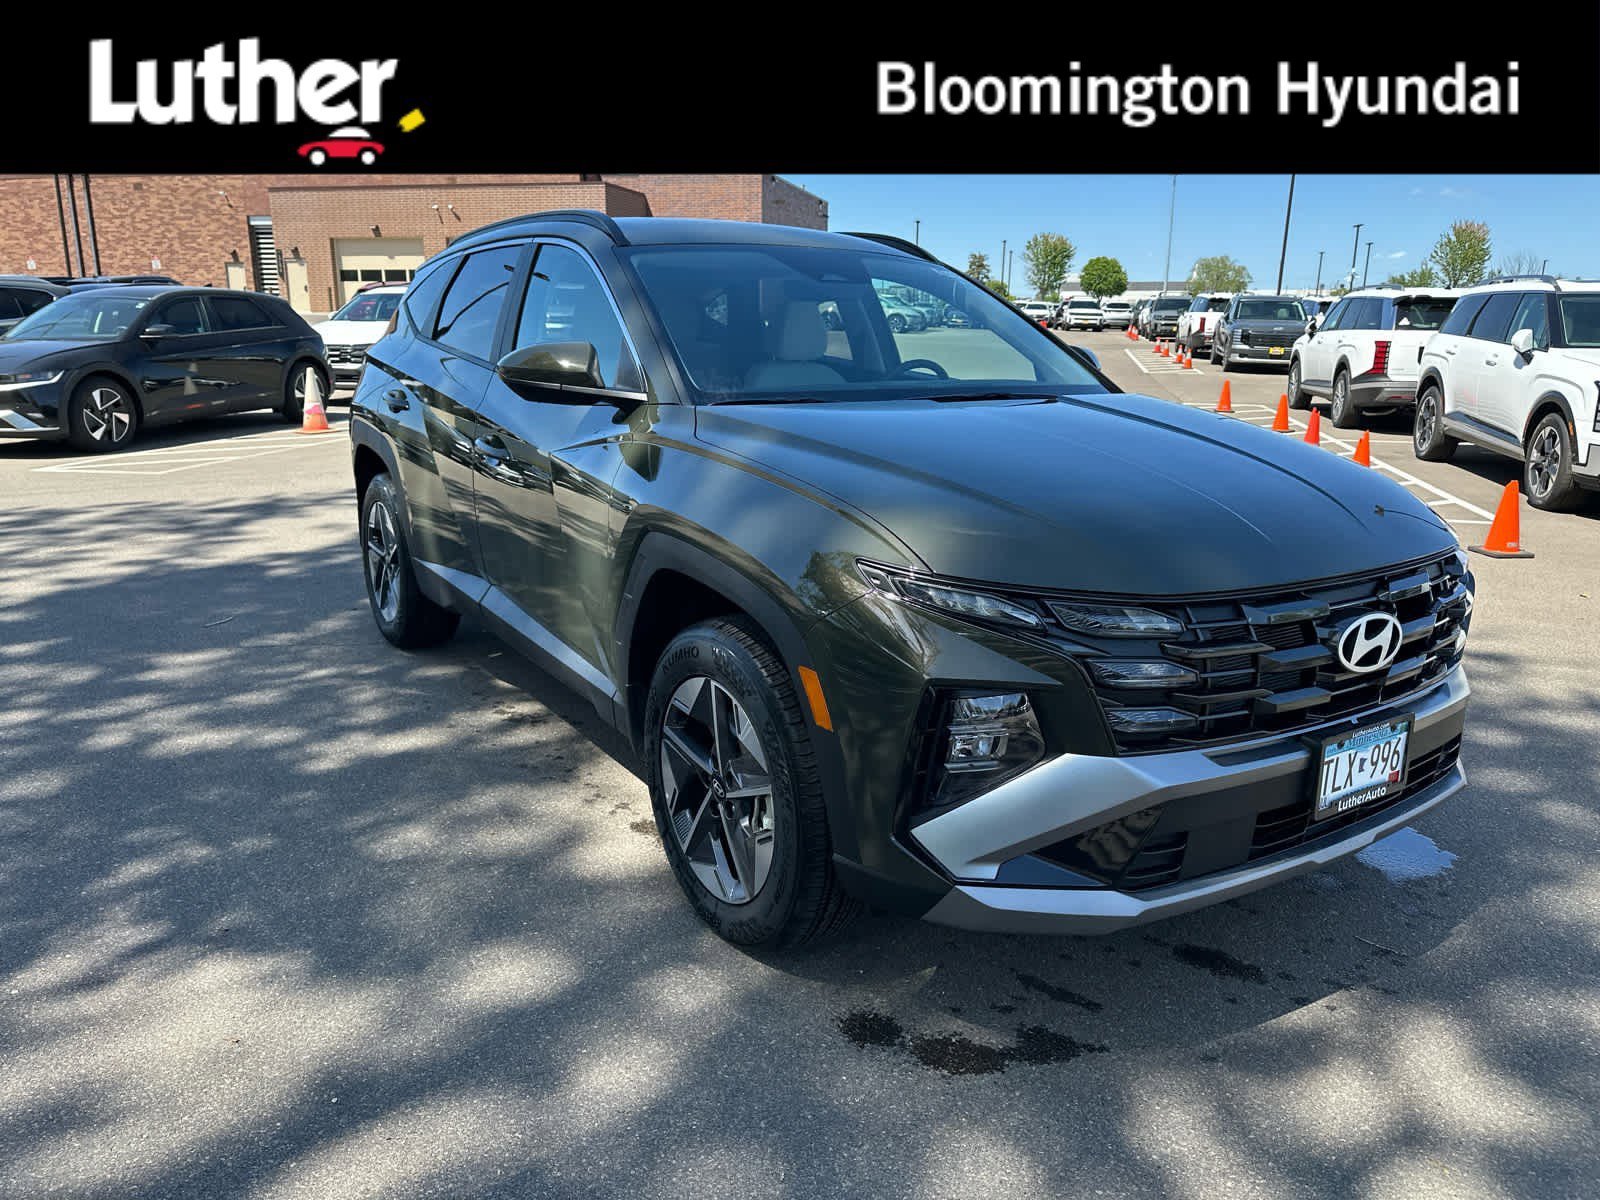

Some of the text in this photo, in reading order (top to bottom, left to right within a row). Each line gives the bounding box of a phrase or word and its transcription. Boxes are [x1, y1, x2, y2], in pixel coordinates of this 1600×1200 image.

[662, 645, 701, 675] KUMHO
[1322, 736, 1402, 797] TLX 996
[1337, 786, 1387, 812] LutherAuto
